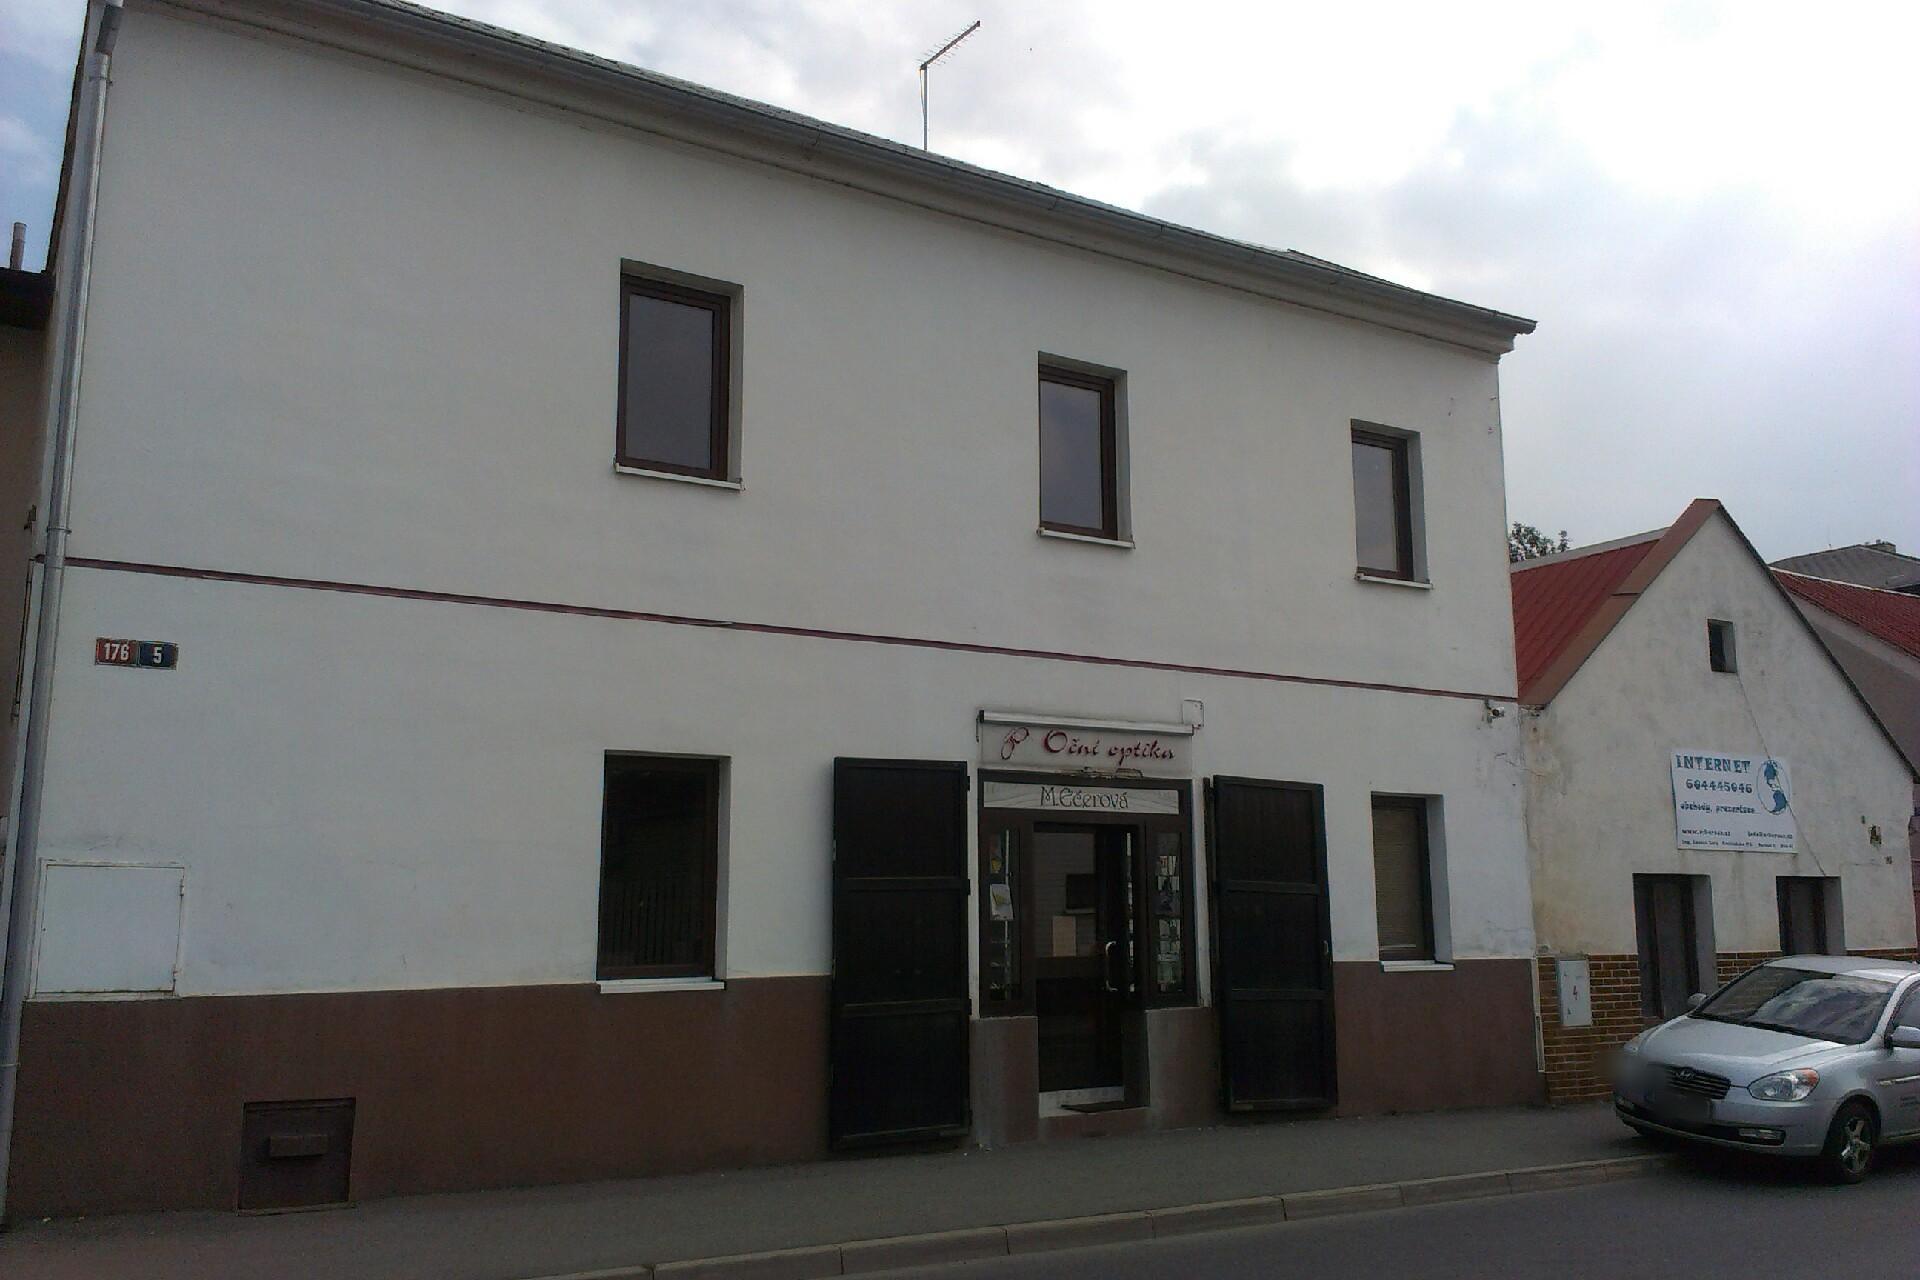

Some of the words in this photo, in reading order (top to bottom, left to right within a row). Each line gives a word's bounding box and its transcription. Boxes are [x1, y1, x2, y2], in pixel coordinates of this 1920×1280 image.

[104, 643, 129, 661] 176
[153, 646, 163, 664] 5
[1108, 739, 1175, 766] optika
[1675, 755, 1751, 773] INTERNET
